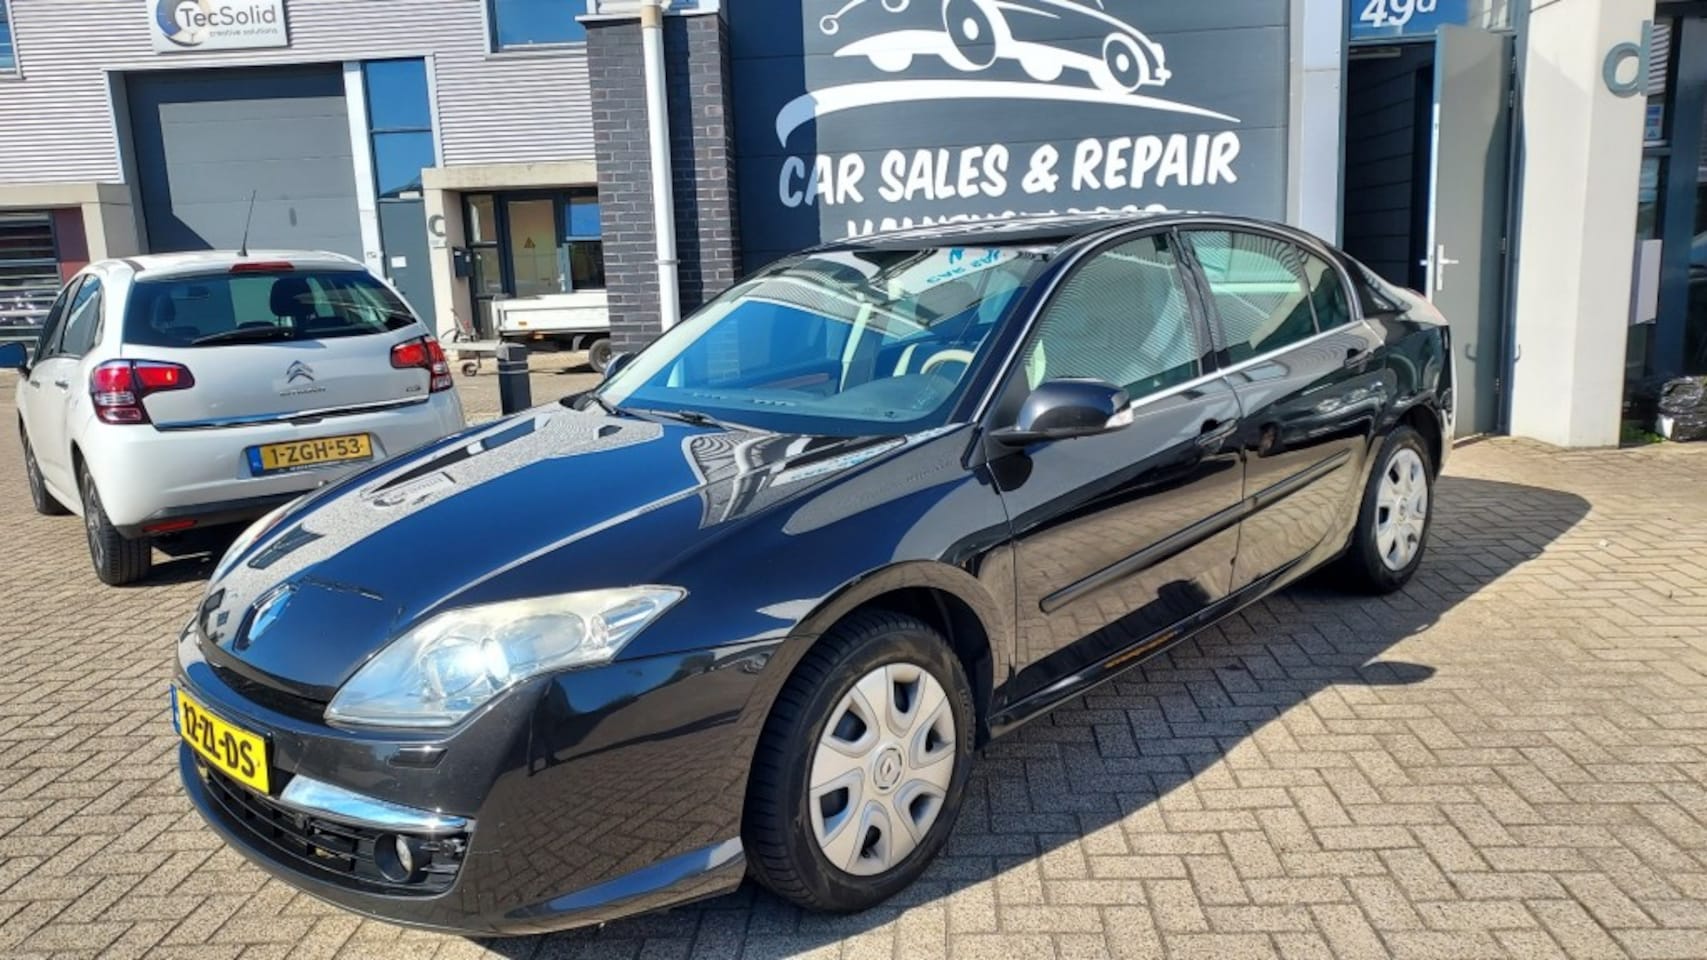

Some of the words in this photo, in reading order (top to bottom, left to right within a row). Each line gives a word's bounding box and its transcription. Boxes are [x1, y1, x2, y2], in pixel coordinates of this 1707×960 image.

[180, 4, 277, 28] TecSolid
[1602, 19, 1652, 98] d
[779, 152, 865, 207] CAR
[878, 143, 1010, 203] SALES
[1021, 143, 1060, 194] &
[1072, 130, 1241, 192] REPAIR
[271, 438, 361, 465] 1-ZGH-53
[183, 701, 256, 778] 12-ZL-DS
